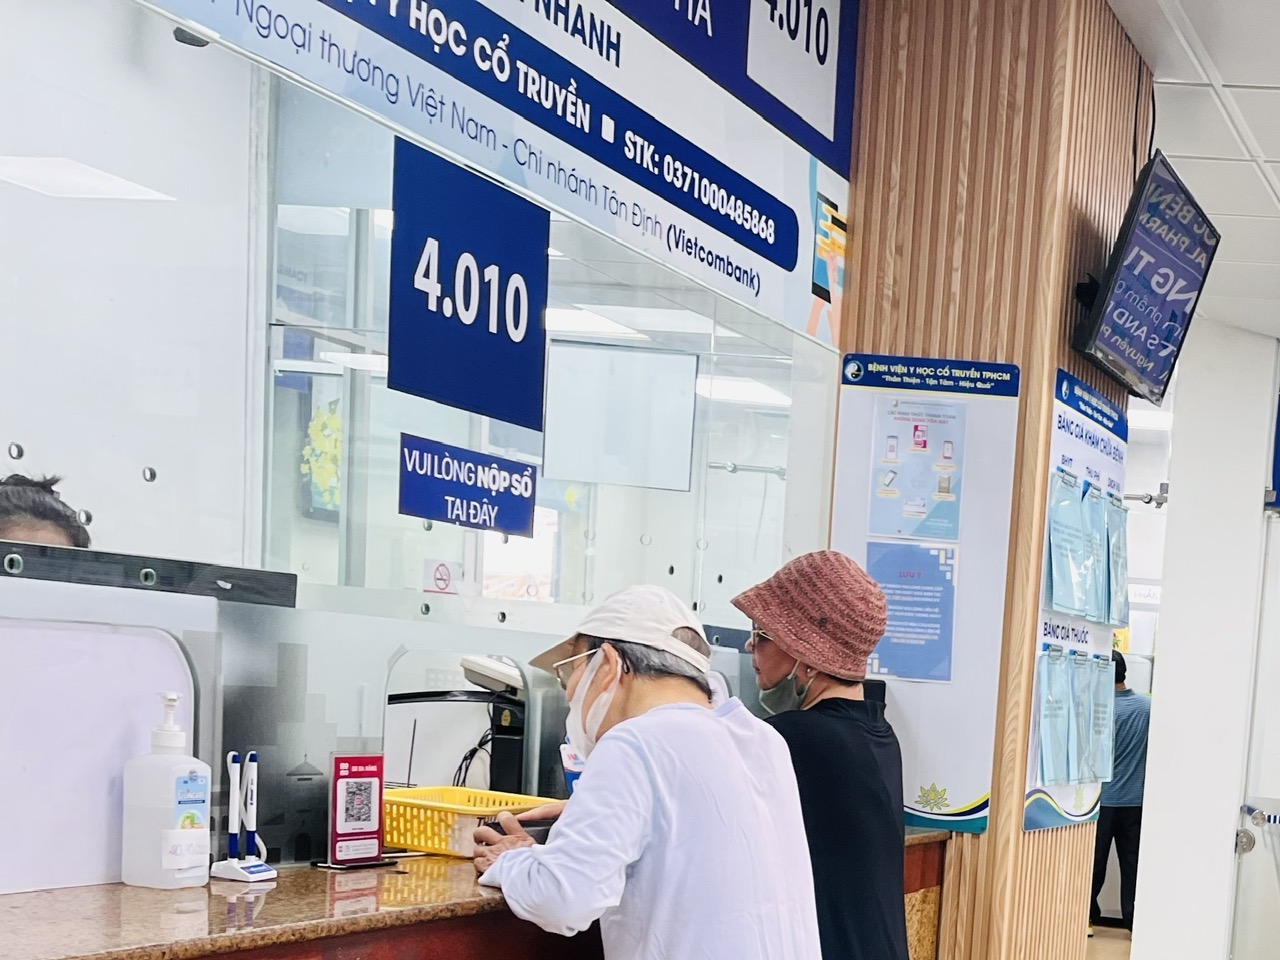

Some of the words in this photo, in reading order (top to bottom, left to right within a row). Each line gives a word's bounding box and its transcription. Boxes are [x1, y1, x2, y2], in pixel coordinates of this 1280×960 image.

[409, 0, 467, 56] HỌC
[473, 33, 511, 82] CỔ
[515, 60, 590, 133] TRUYỀN
[624, 130, 659, 175] STK:
[663, 154, 775, 244] 0371000485868
[236, 0, 312, 54] Ngoại
[320, 30, 399, 104] thương
[406, 75, 446, 124] Việt
[451, 101, 497, 150] Nam
[513, 138, 543, 168] Chi
[547, 160, 598, 206] nhánh
[602, 185, 628, 218] Tân
[632, 202, 663, 240] Định
[667, 224, 761, 297] (Vietcombank)
[413, 236, 528, 343] 4.010
[868, 361, 888, 374] BỆNH
[890, 363, 908, 375] VIỆN
[909, 366, 915, 374] Y
[916, 367, 935, 376] HỌC
[982, 371, 1011, 381] TPHCM
[1058, 411, 1074, 436] BẢNG
[404, 447, 431, 476] VUI
[433, 452, 475, 486] LÒNG
[477, 463, 510, 496] NỘP
[511, 467, 532, 498] SỔ
[444, 496, 467, 526] TẠI
[469, 498, 498, 527] ĐÂY
[1043, 618, 1060, 639] BẢNG
[1060, 624, 1070, 641] GIÁ
[1071, 626, 1089, 644] THUỐC
